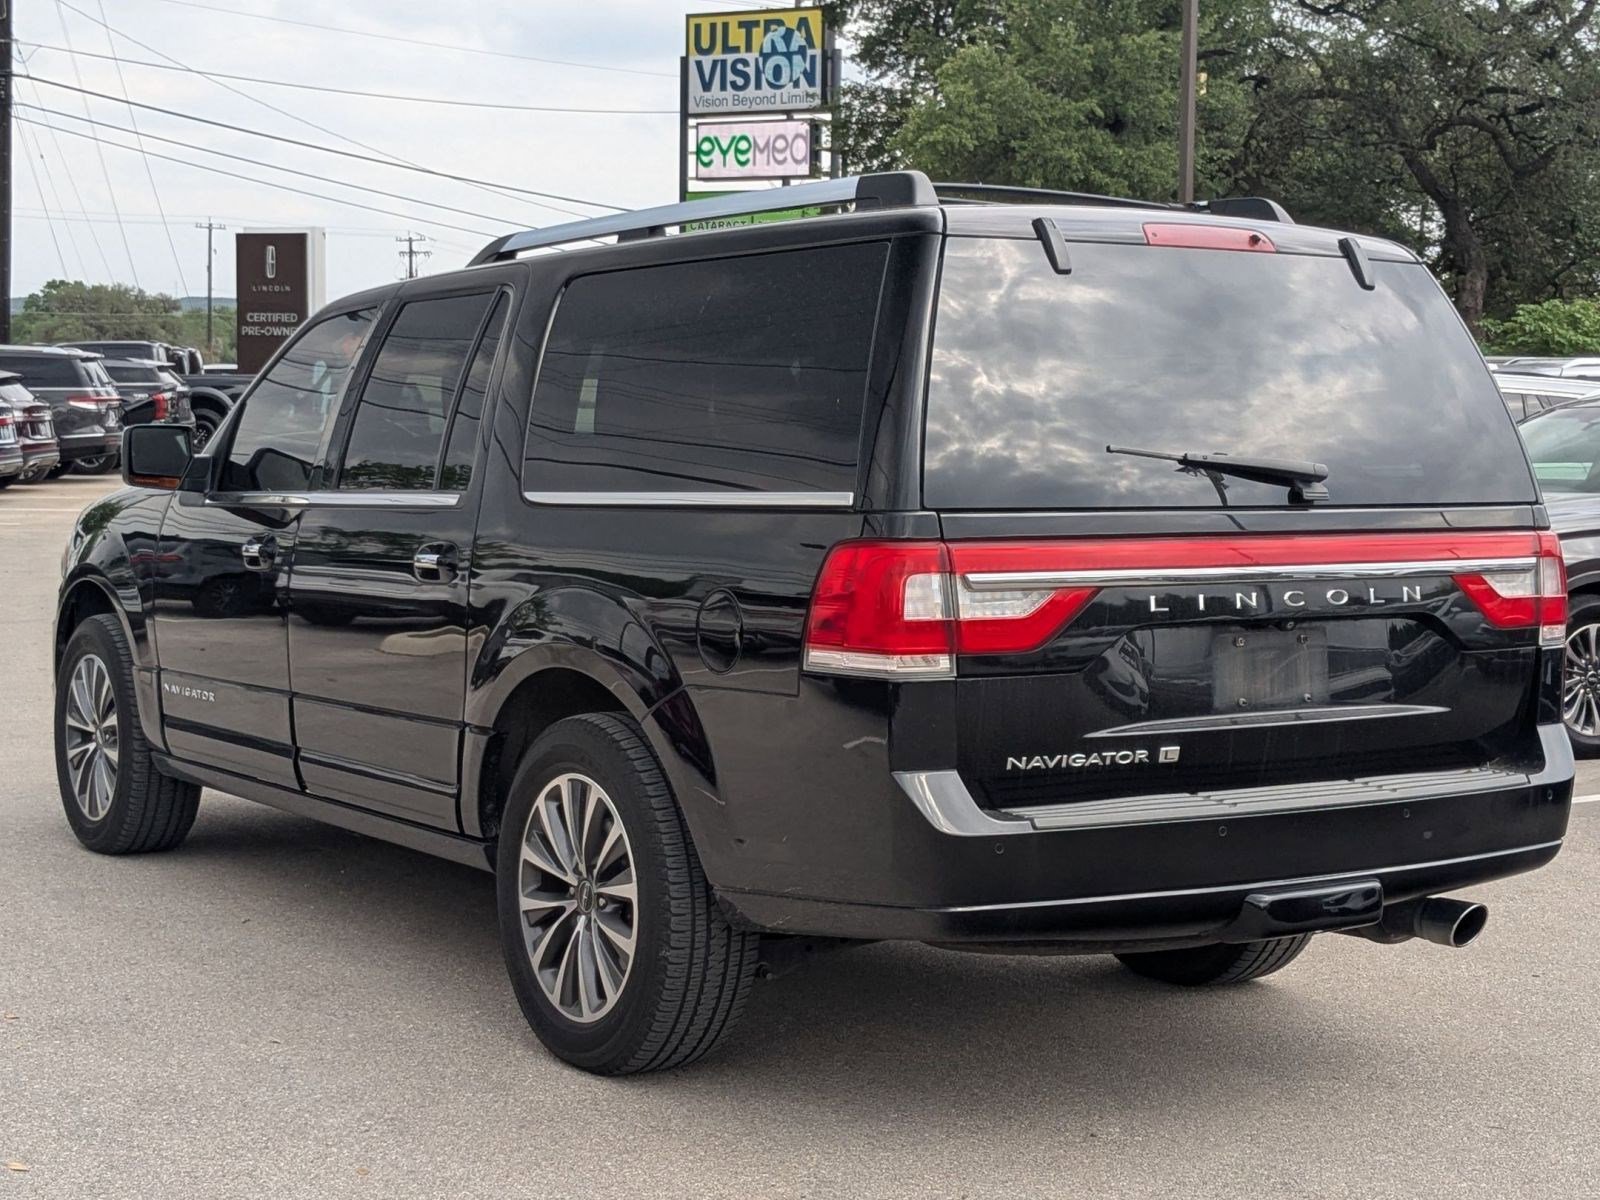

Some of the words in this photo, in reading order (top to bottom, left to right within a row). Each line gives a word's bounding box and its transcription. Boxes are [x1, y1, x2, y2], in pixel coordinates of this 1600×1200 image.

[694, 17, 816, 56] ULTRA
[695, 54, 817, 92] VISION
[693, 95, 728, 108] Vision
[732, 94, 776, 109] Beyond
[780, 91, 816, 105] Limits
[246, 312, 298, 322] CERTIFIED
[1150, 586, 1422, 612] LINCOLN
[164, 683, 216, 702] NAVIGATOR
[1006, 750, 1150, 770] NAVIGATOR
